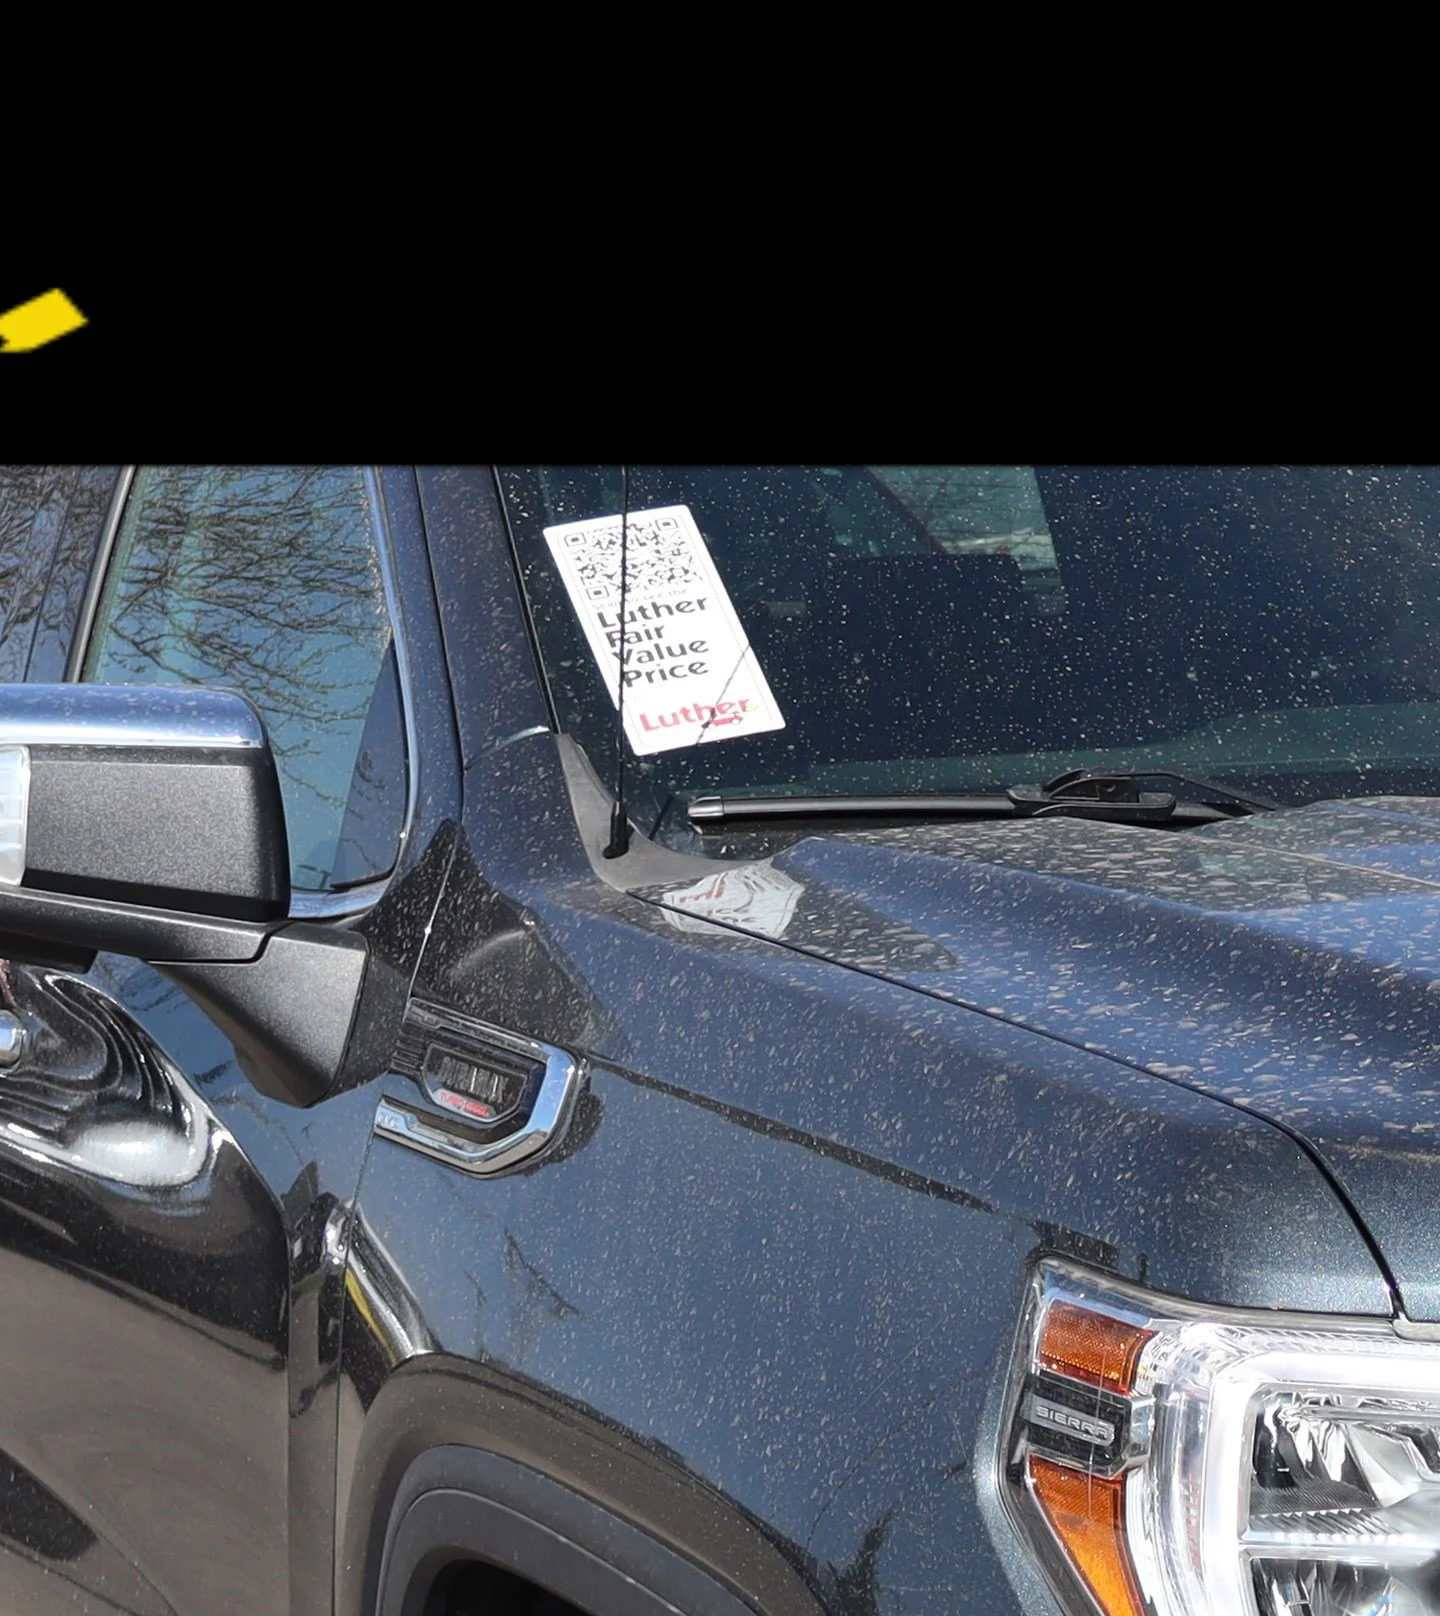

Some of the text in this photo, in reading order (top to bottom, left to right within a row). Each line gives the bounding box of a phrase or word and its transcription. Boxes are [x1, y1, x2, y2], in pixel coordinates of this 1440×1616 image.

[597, 597, 707, 628] Luther
[605, 624, 664, 648] Fair
[612, 640, 709, 666] Value
[623, 661, 709, 688] Price
[640, 699, 749, 731] Luther
[1035, 1405, 1109, 1440] SIERRA
